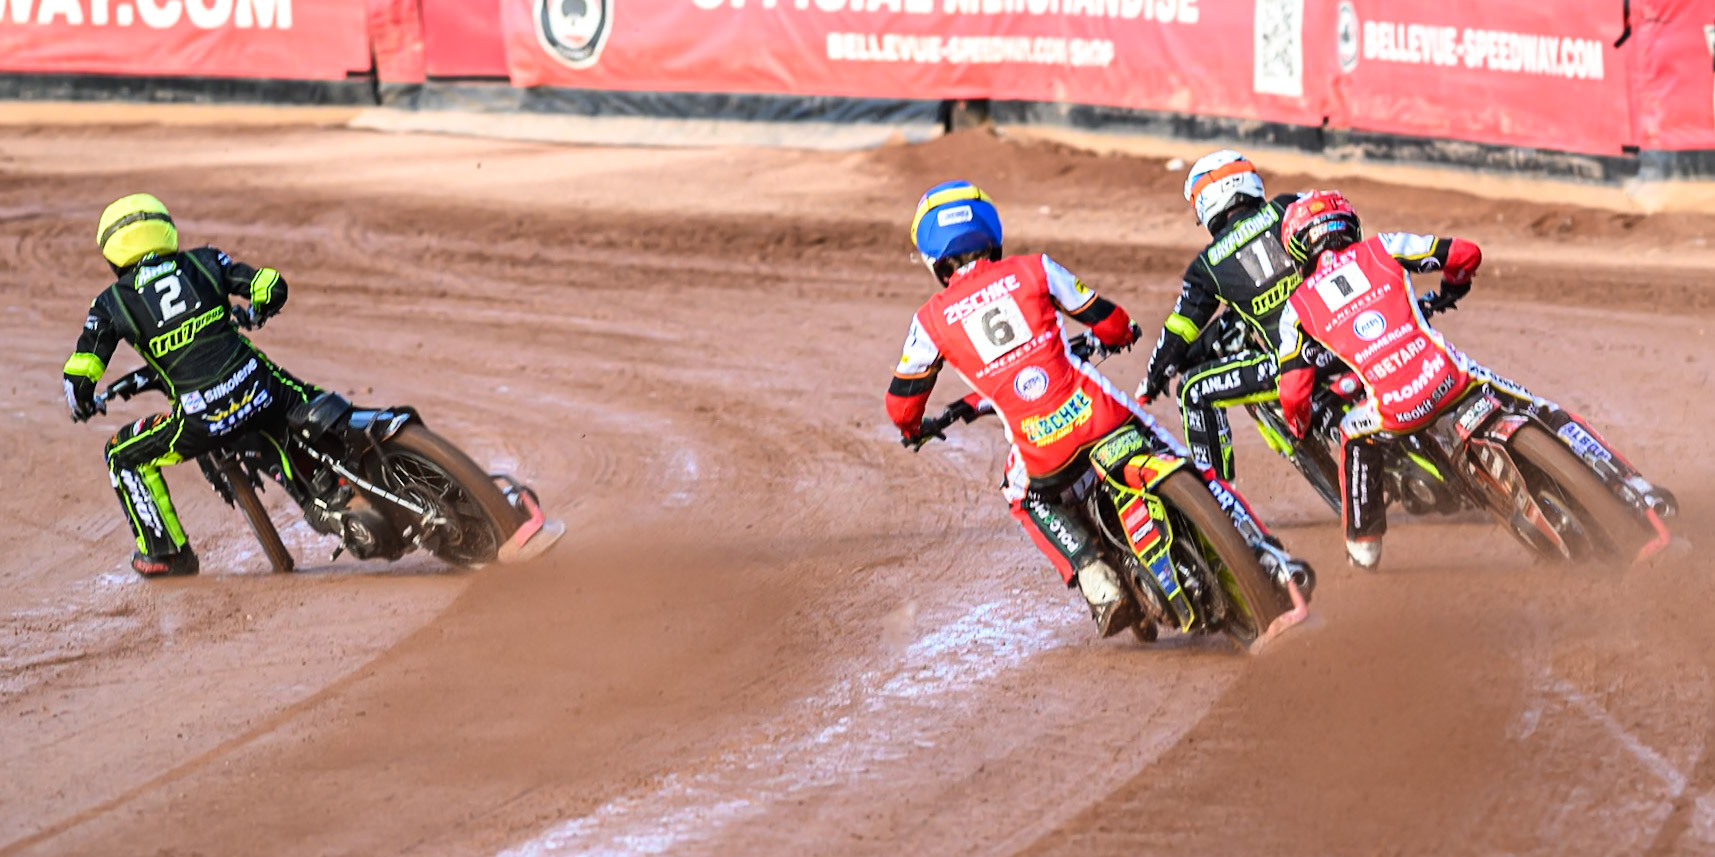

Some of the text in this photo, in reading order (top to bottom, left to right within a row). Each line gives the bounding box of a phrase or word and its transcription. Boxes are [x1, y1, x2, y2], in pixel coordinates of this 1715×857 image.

[1251, 239, 1275, 279] 1
[154, 274, 187, 321] 2
[943, 274, 1020, 325] ZISCHKE
[1330, 274, 1354, 297] 1
[981, 306, 1015, 347] 6
[1372, 336, 1426, 379] BETARD
[203, 357, 258, 403] Silkolene
[1201, 369, 1242, 396] ANLAS
[1431, 373, 1456, 402] SDK
